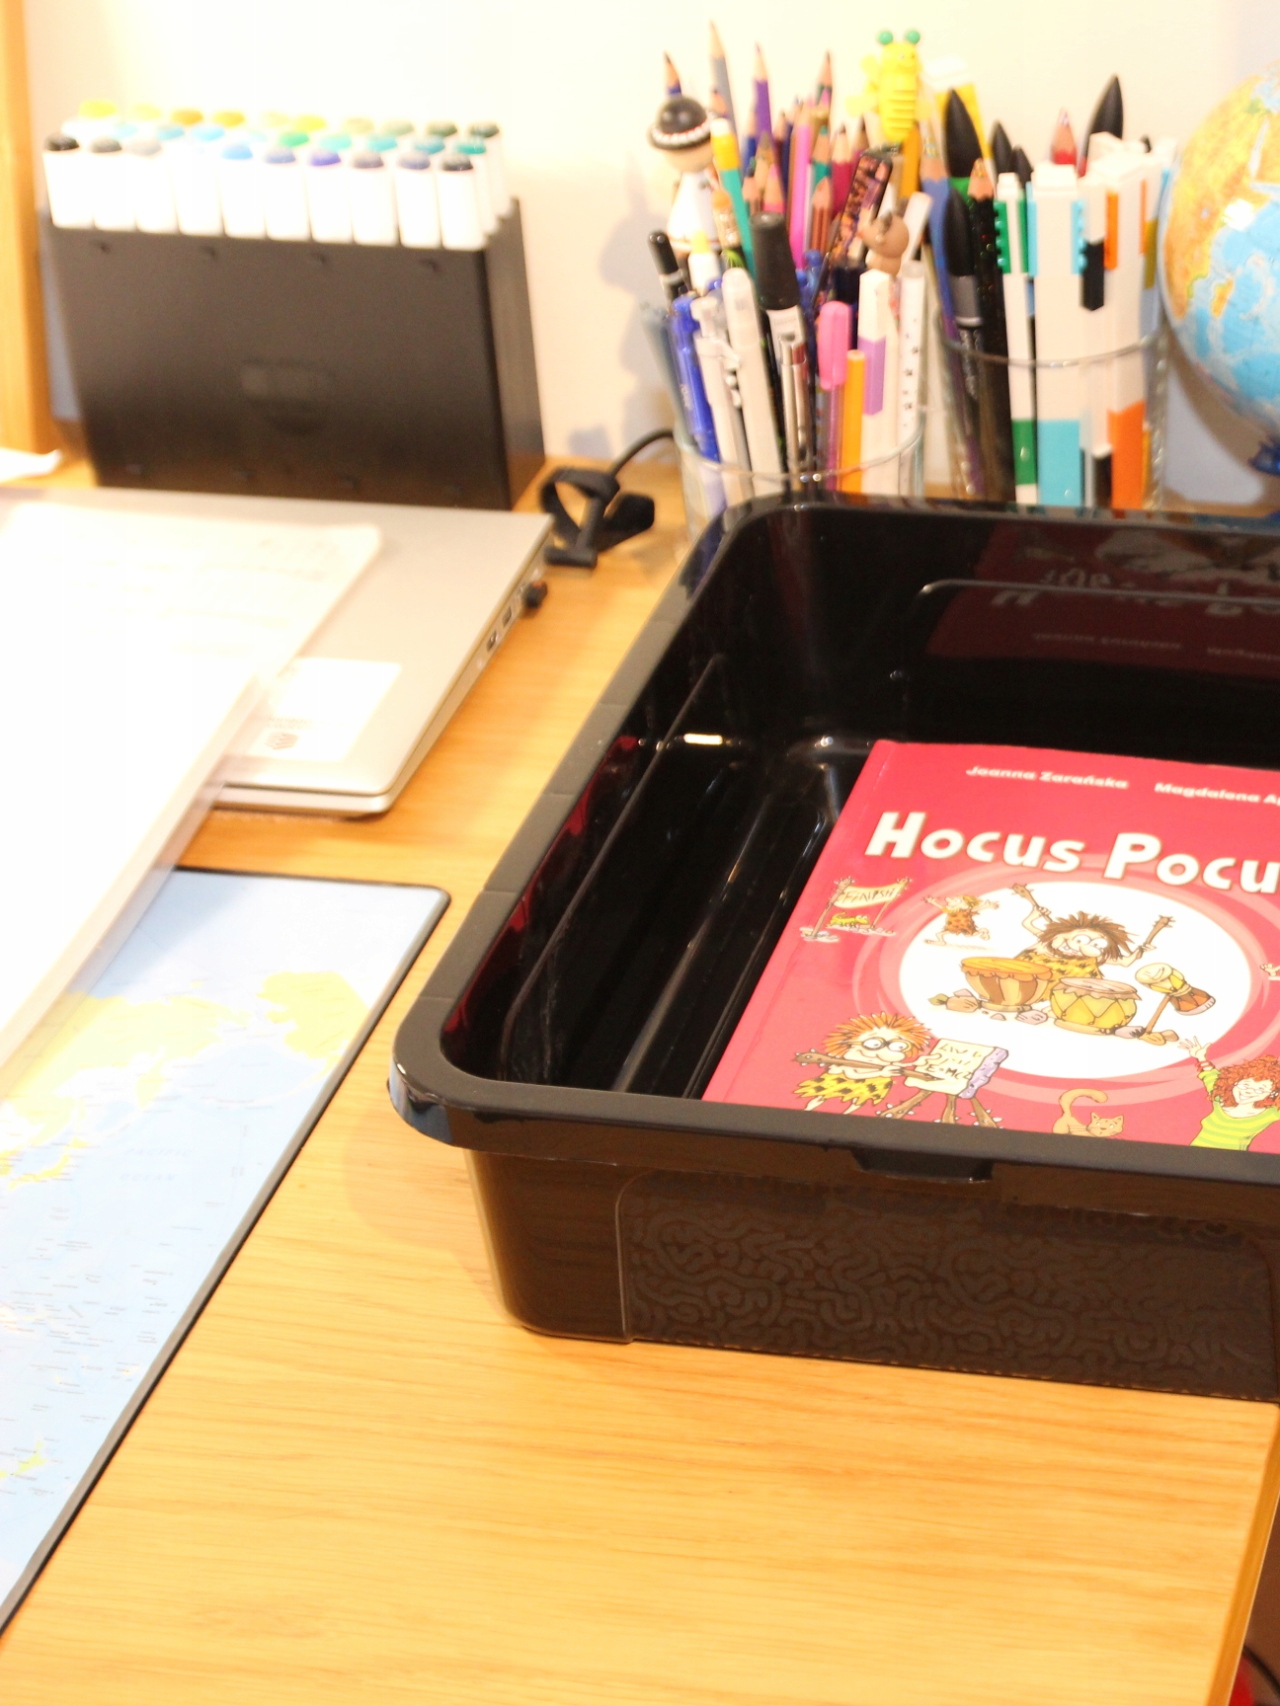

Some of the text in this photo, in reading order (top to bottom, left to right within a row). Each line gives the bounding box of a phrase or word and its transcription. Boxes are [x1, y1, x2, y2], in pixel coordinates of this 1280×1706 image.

[966, 766, 1129, 789] Joanna Zarańska
[1154, 783, 1260, 802] Magdalena
[864, 811, 1085, 873] Hocus
